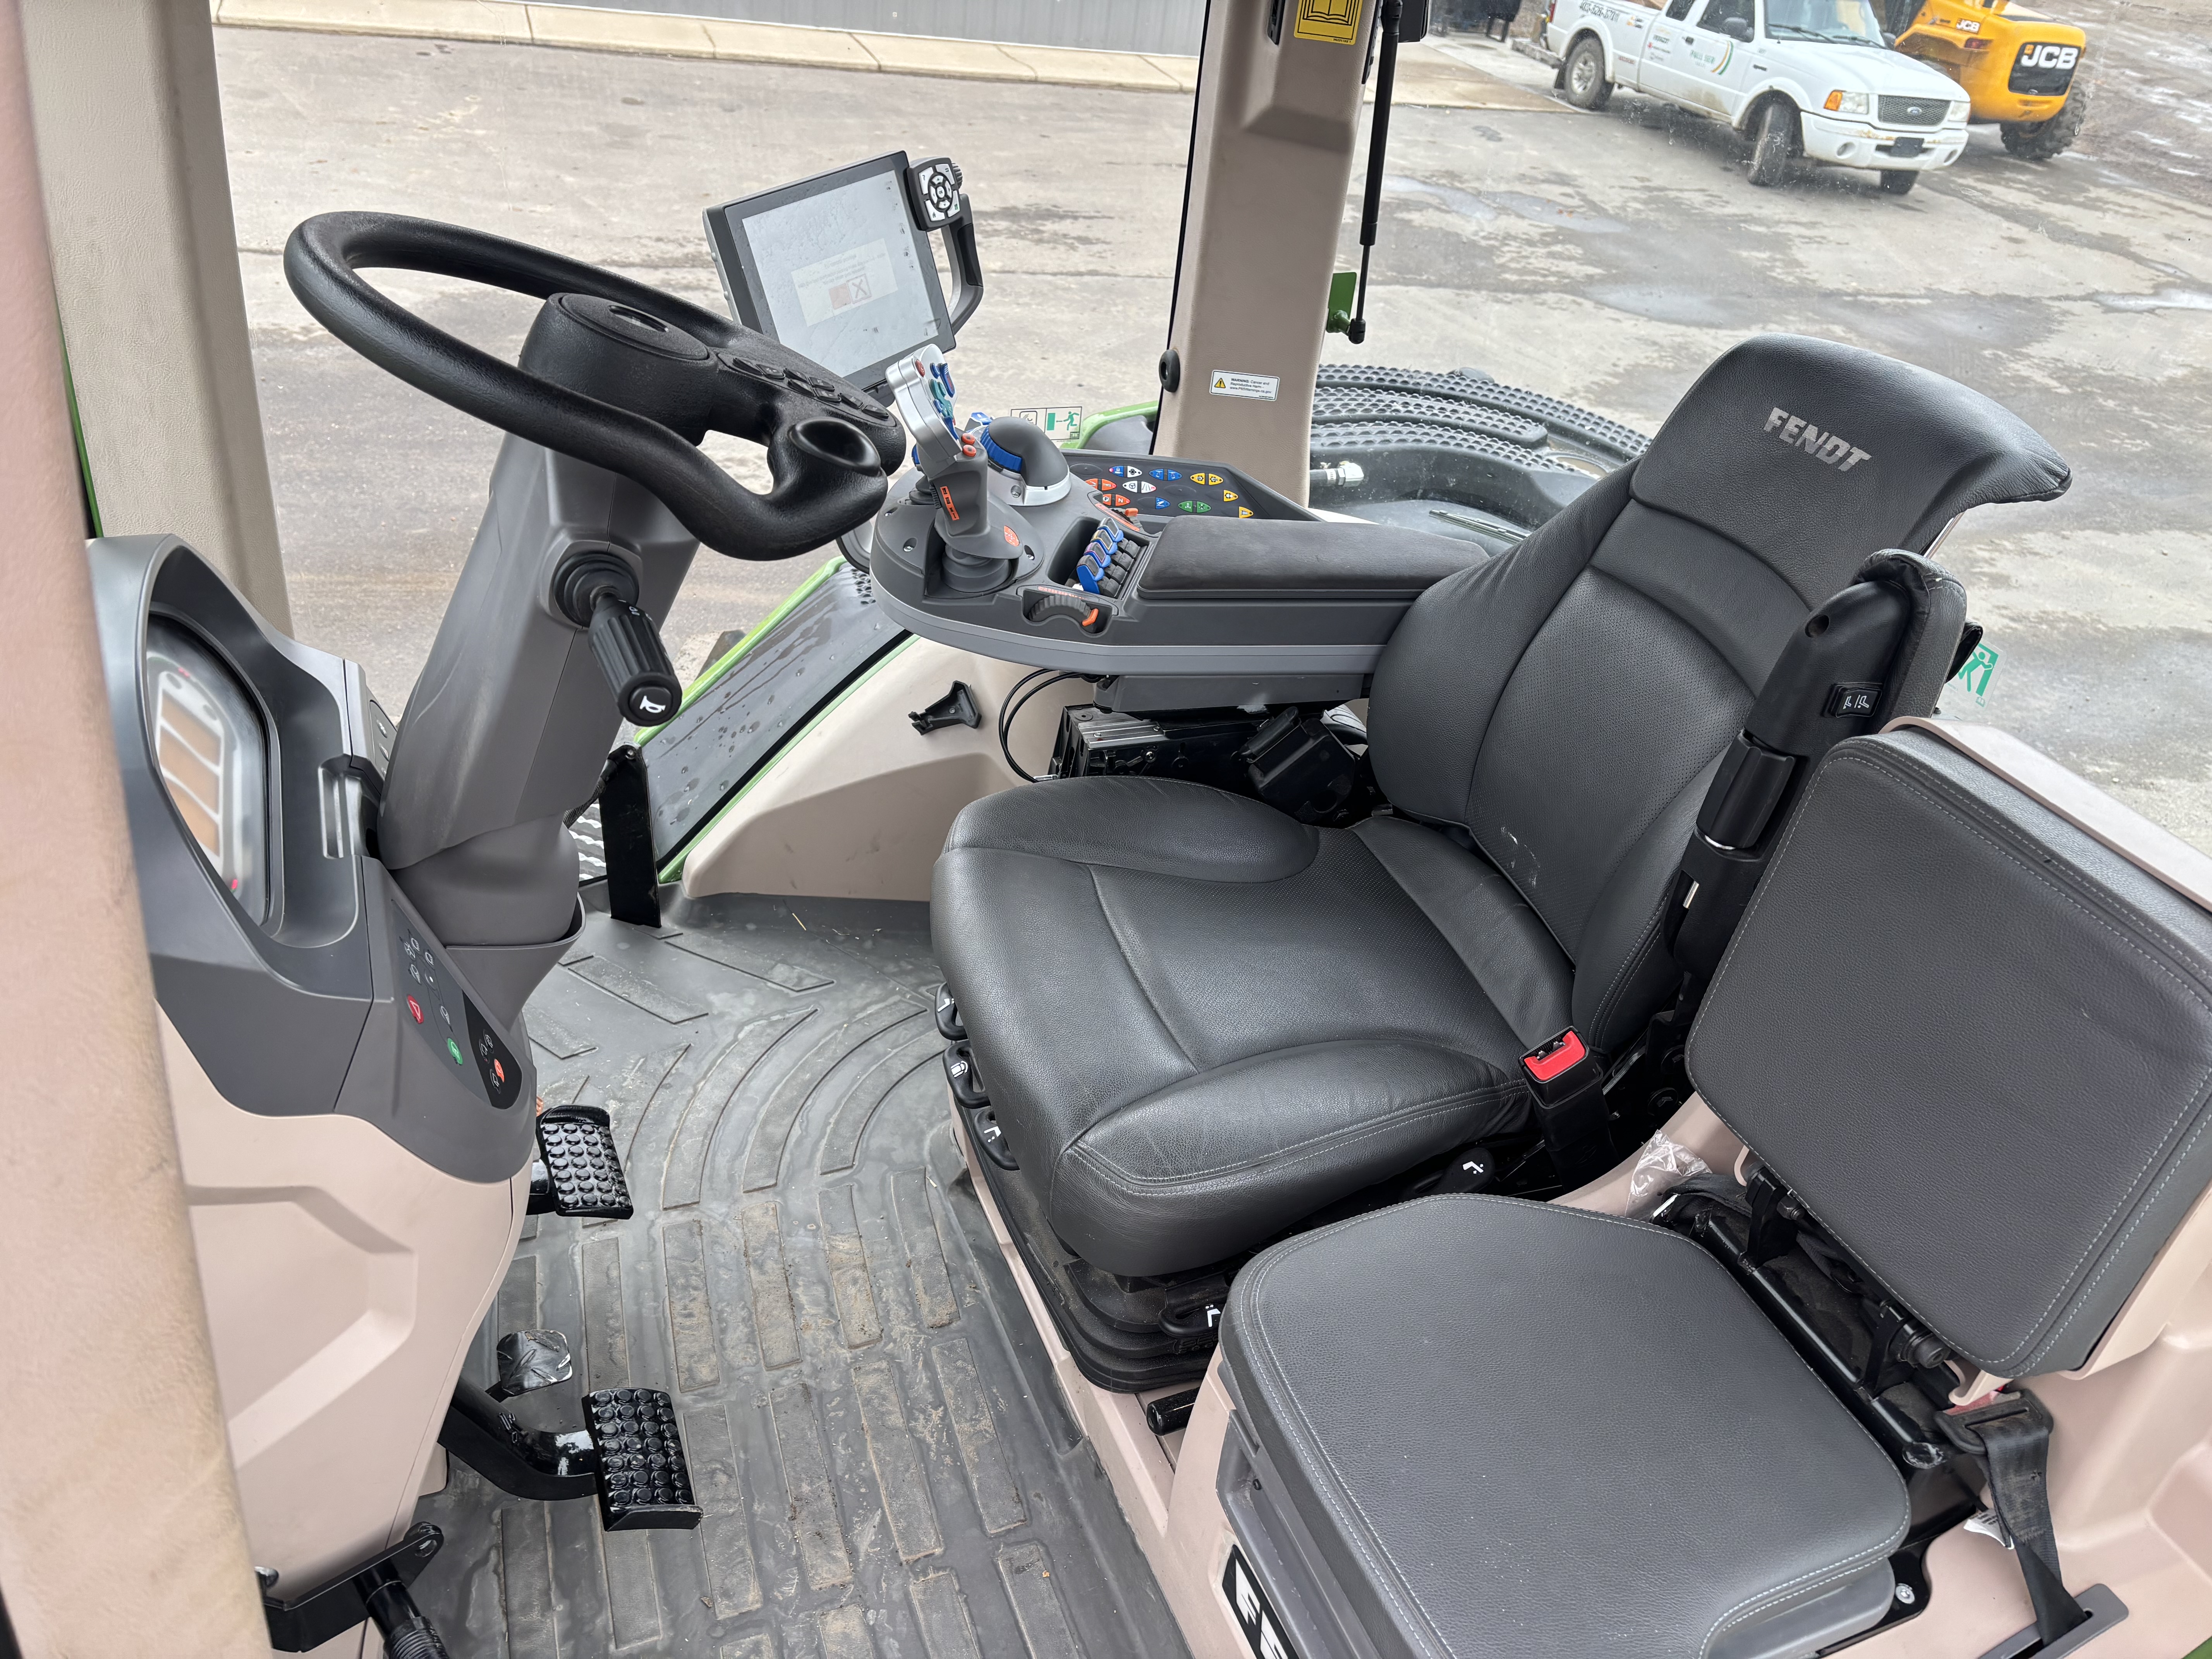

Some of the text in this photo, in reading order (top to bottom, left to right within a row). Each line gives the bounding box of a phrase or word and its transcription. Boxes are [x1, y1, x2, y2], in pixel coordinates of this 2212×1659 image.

[1956, 19, 1980, 33] JCB
[2021, 45, 2078, 69] JCB
[1764, 407, 1872, 471] FENDT
